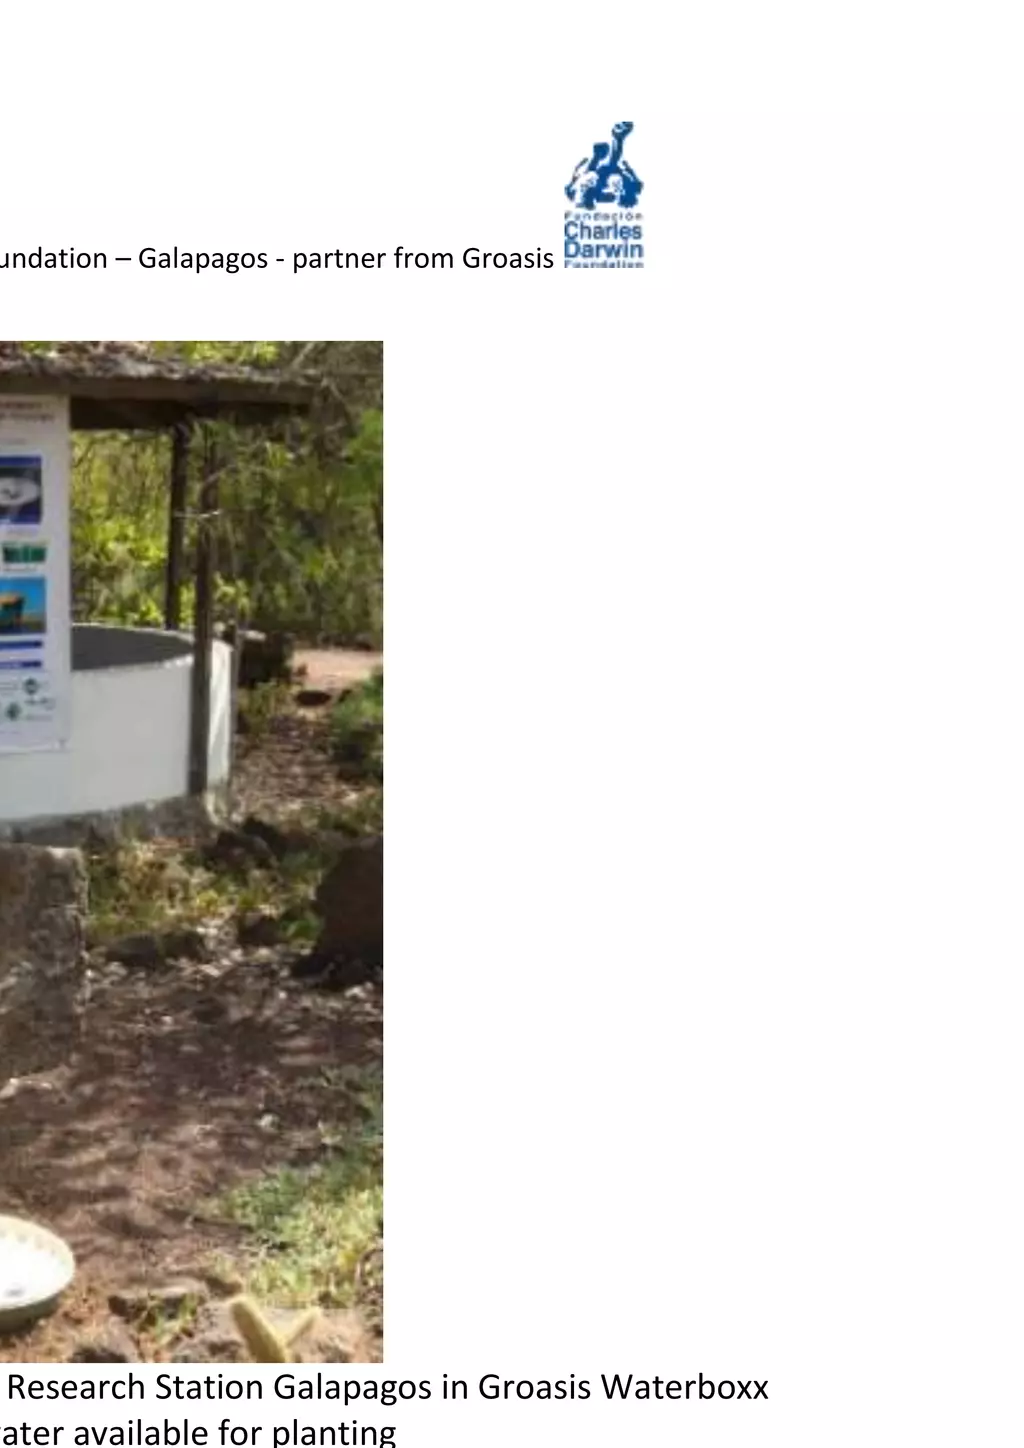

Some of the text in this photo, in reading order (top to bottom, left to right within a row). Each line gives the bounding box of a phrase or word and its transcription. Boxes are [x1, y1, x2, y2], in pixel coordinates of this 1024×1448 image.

[564, 221, 643, 240] Charles
[138, 245, 268, 274] Galapagos
[293, 248, 387, 274] partner
[393, 245, 454, 269] from
[462, 247, 554, 269] Groasis
[564, 240, 644, 258] Darwin
[8, 1372, 145, 1400] Research
[155, 1373, 263, 1400] Station
[273, 1372, 432, 1407] Galapagos
[442, 1373, 468, 1400] in
[478, 1373, 591, 1400] Groasis
[600, 1372, 769, 1400] Waterboxx
[74, 1418, 209, 1446] available
[217, 1418, 263, 1446] for
